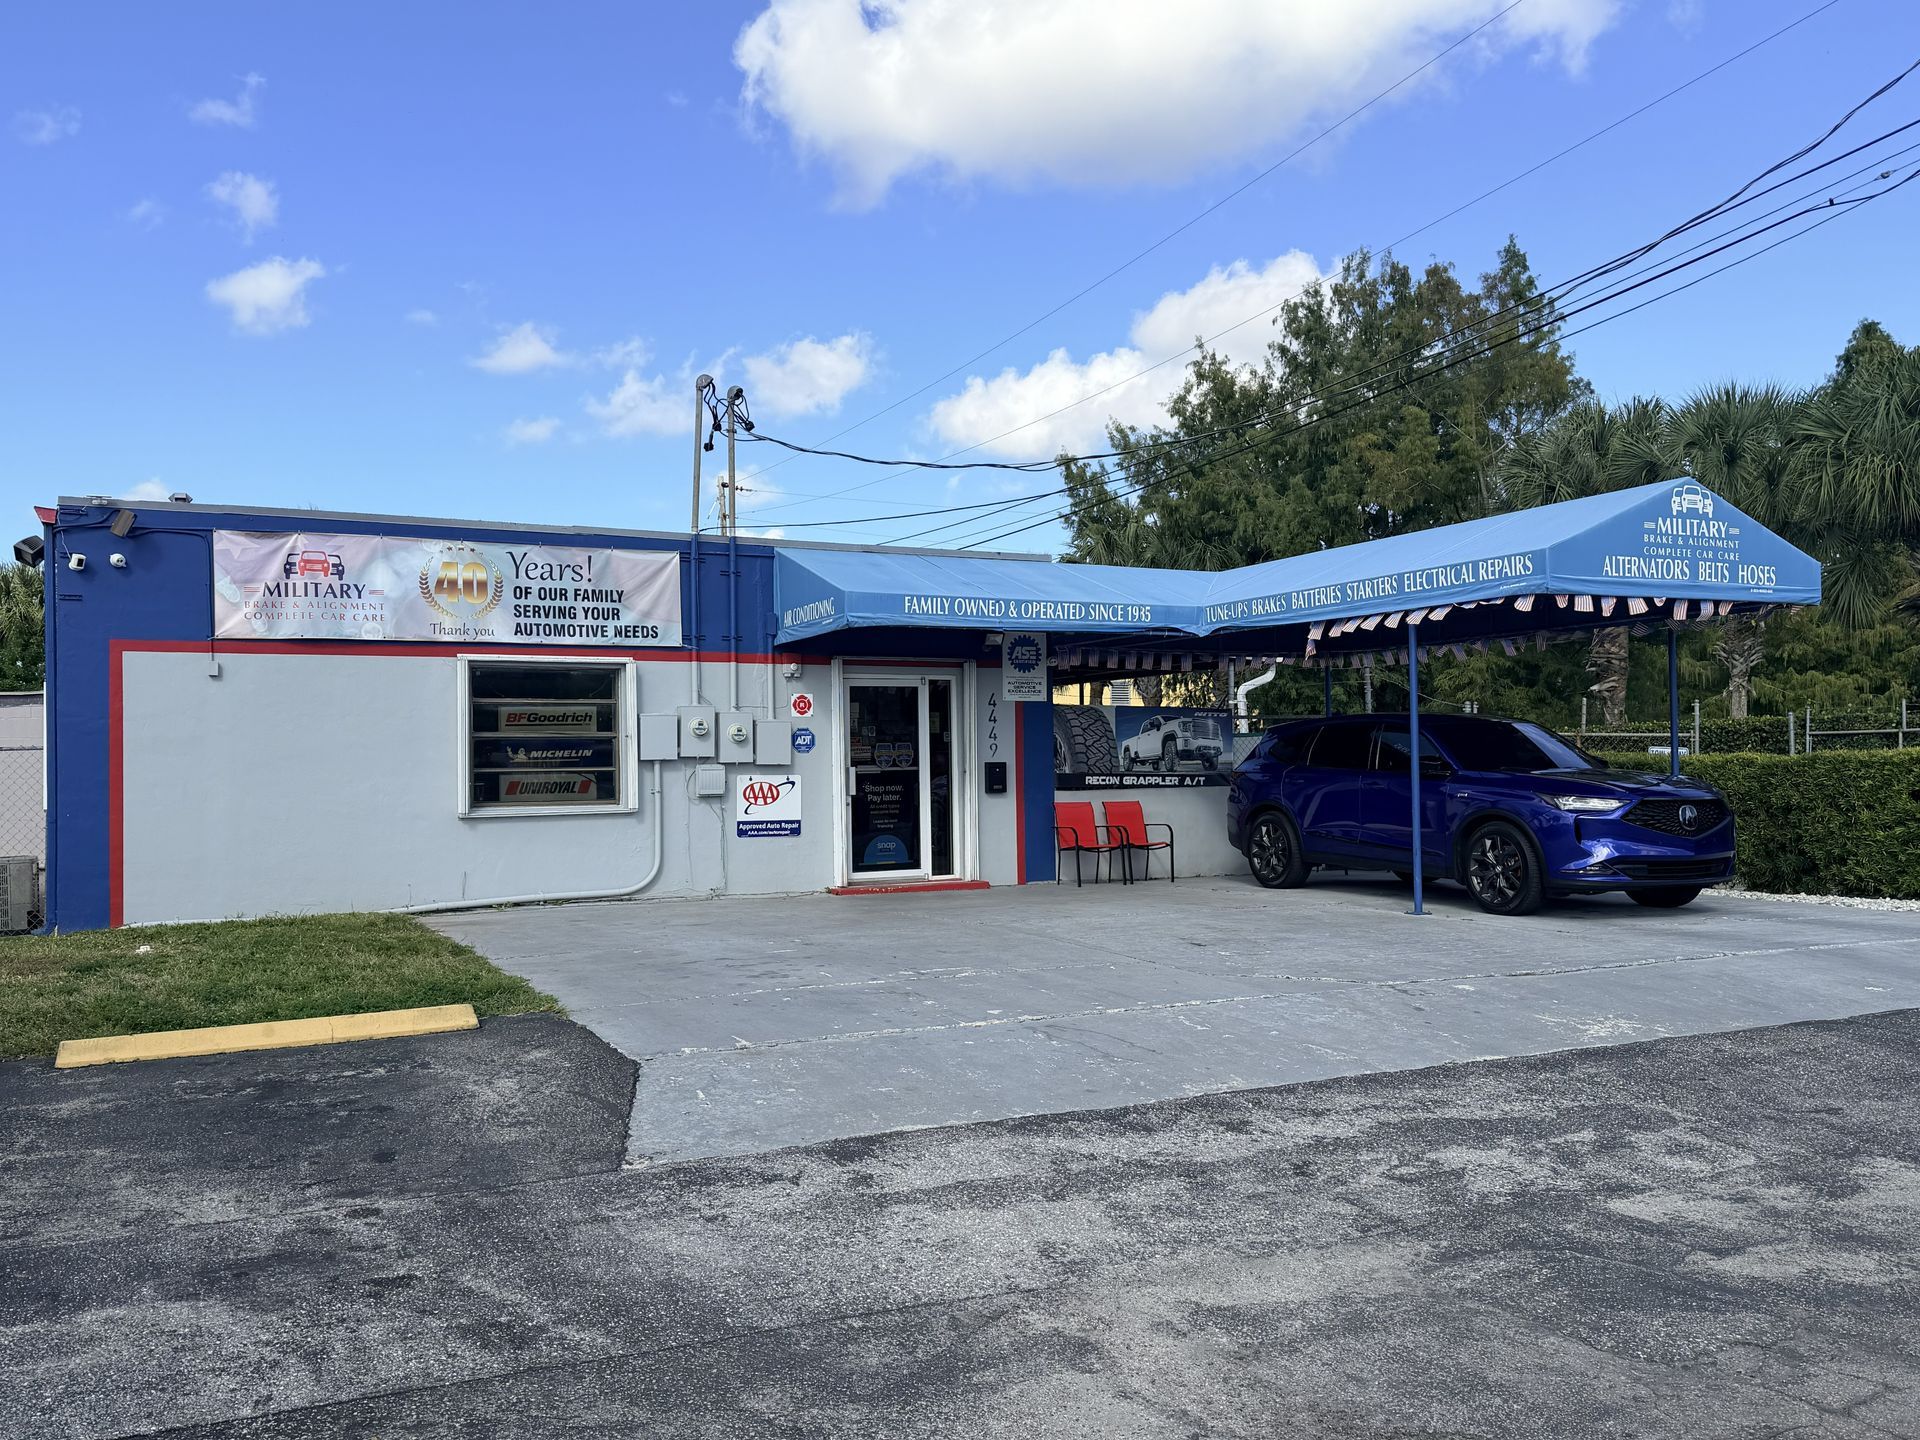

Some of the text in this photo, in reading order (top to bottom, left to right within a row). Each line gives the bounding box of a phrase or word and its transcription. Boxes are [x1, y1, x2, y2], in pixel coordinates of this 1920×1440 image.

[1657, 517, 1728, 538] MILITARY
[1643, 534, 1740, 549] BRAKE & ALIGNMENT
[1643, 546, 1740, 561] COMPLETE CAR CARE
[434, 551, 593, 604] 40 Years!
[1603, 555, 1776, 586] ALTERNATORS BELTS HOSES
[262, 581, 366, 600] MILITARY
[513, 585, 624, 604] OF OUR FAMILY
[1206, 554, 1533, 623] TUNE-UPS BRAKES BATTERIES STARTERS ELECTRICAL REPAIRS
[244, 600, 385, 611] BRAKE & ALIGNMENT
[792, 597, 835, 625] CONDITIONING
[904, 596, 951, 616] FAMILY
[954, 597, 1005, 618] OWNED
[1008, 600, 1019, 618] &
[1021, 600, 1085, 620] OPERATED
[1088, 603, 1124, 621] SINCE
[244, 611, 385, 622] COMPLETE CAR CARE
[513, 605, 621, 622] SERVING YOUR
[430, 622, 495, 641] Thank you
[513, 622, 659, 639] AUTOMOTIVE NEEDS
[1012, 646, 1037, 660] ASE
[505, 712, 593, 723] BFGoodrich
[988, 692, 998, 758] 4449
[795, 735, 812, 745] ADT
[529, 749, 593, 758] MICHELIN
[518, 780, 579, 795] UNIROYAL
[1085, 775, 1206, 786] RECON GRAPPLER A/T
[744, 782, 778, 805] AAA
[865, 784, 885, 793] Shop
[867, 794, 882, 803] Pay
[739, 822, 767, 831] Approved
[781, 821, 799, 830] Repair
[877, 841, 897, 851] snap
